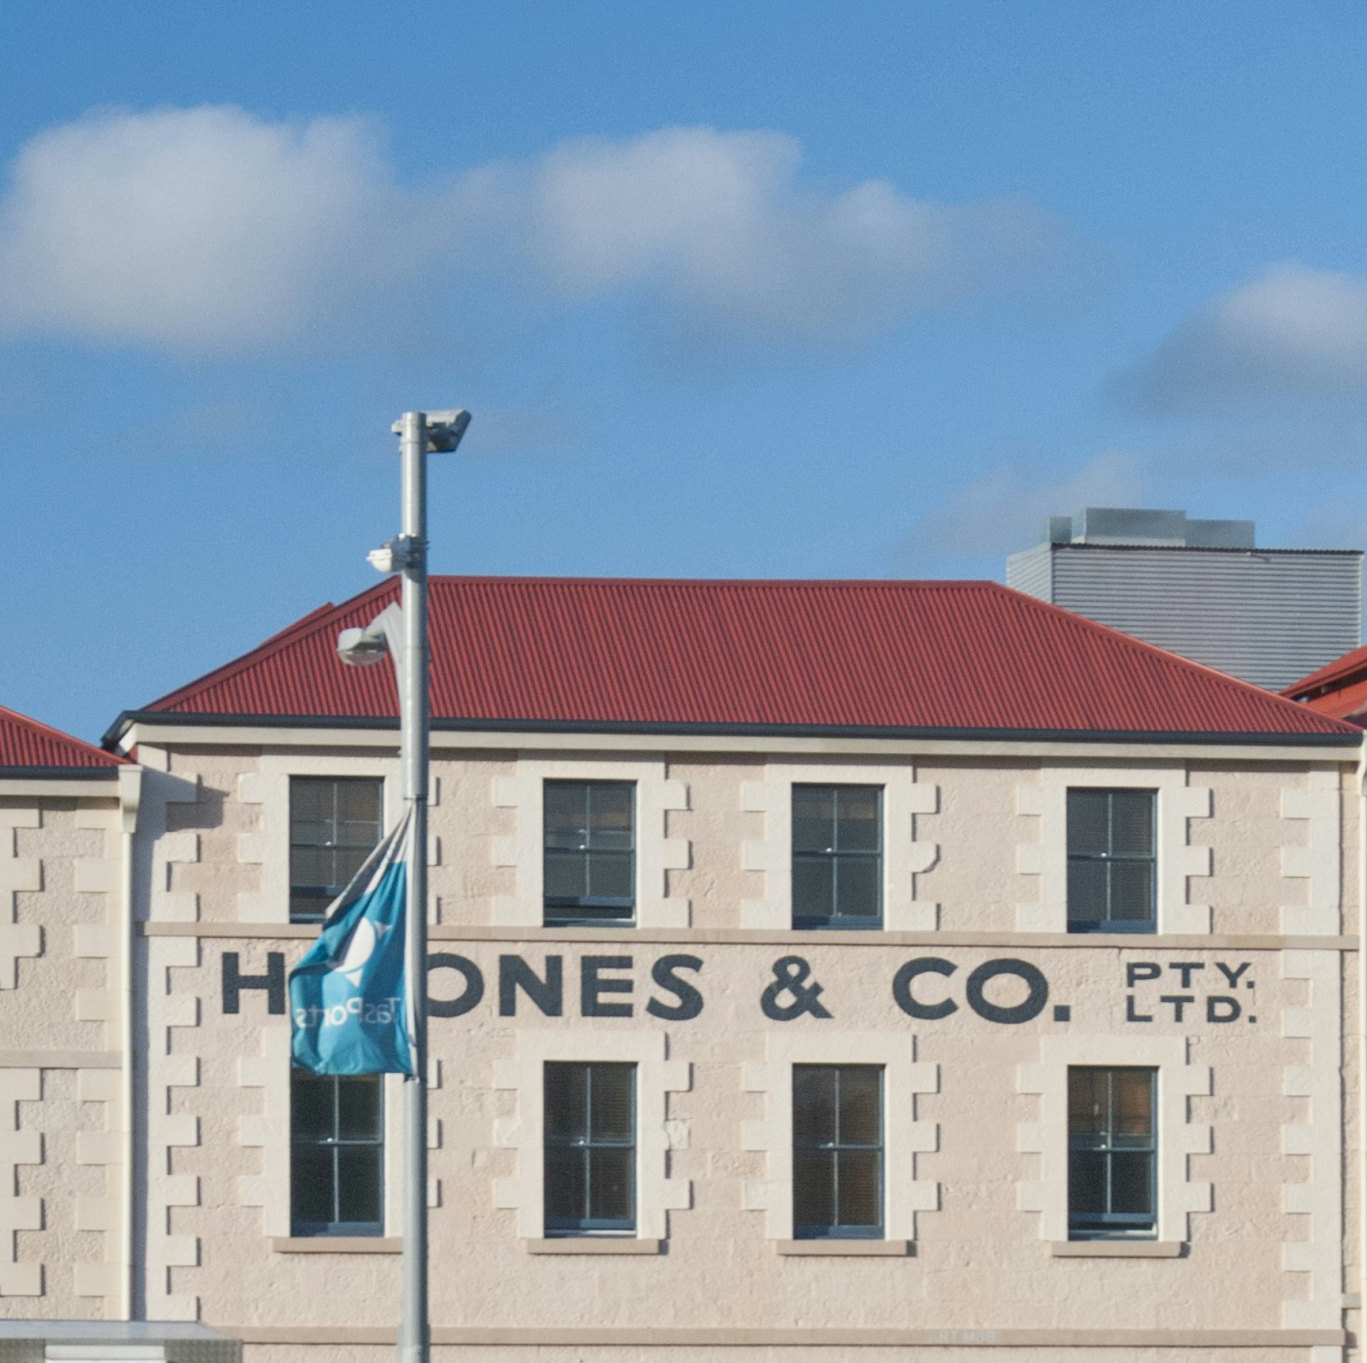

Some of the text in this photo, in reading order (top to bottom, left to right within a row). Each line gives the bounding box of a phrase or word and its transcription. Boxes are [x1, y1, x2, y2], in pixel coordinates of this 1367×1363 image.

[423, 953, 705, 1021] ONES
[760, 955, 831, 1021] &
[892, 957, 1071, 1024] CO.
[1126, 961, 1255, 990] PTY.
[1126, 995, 1258, 1023] LTD.
